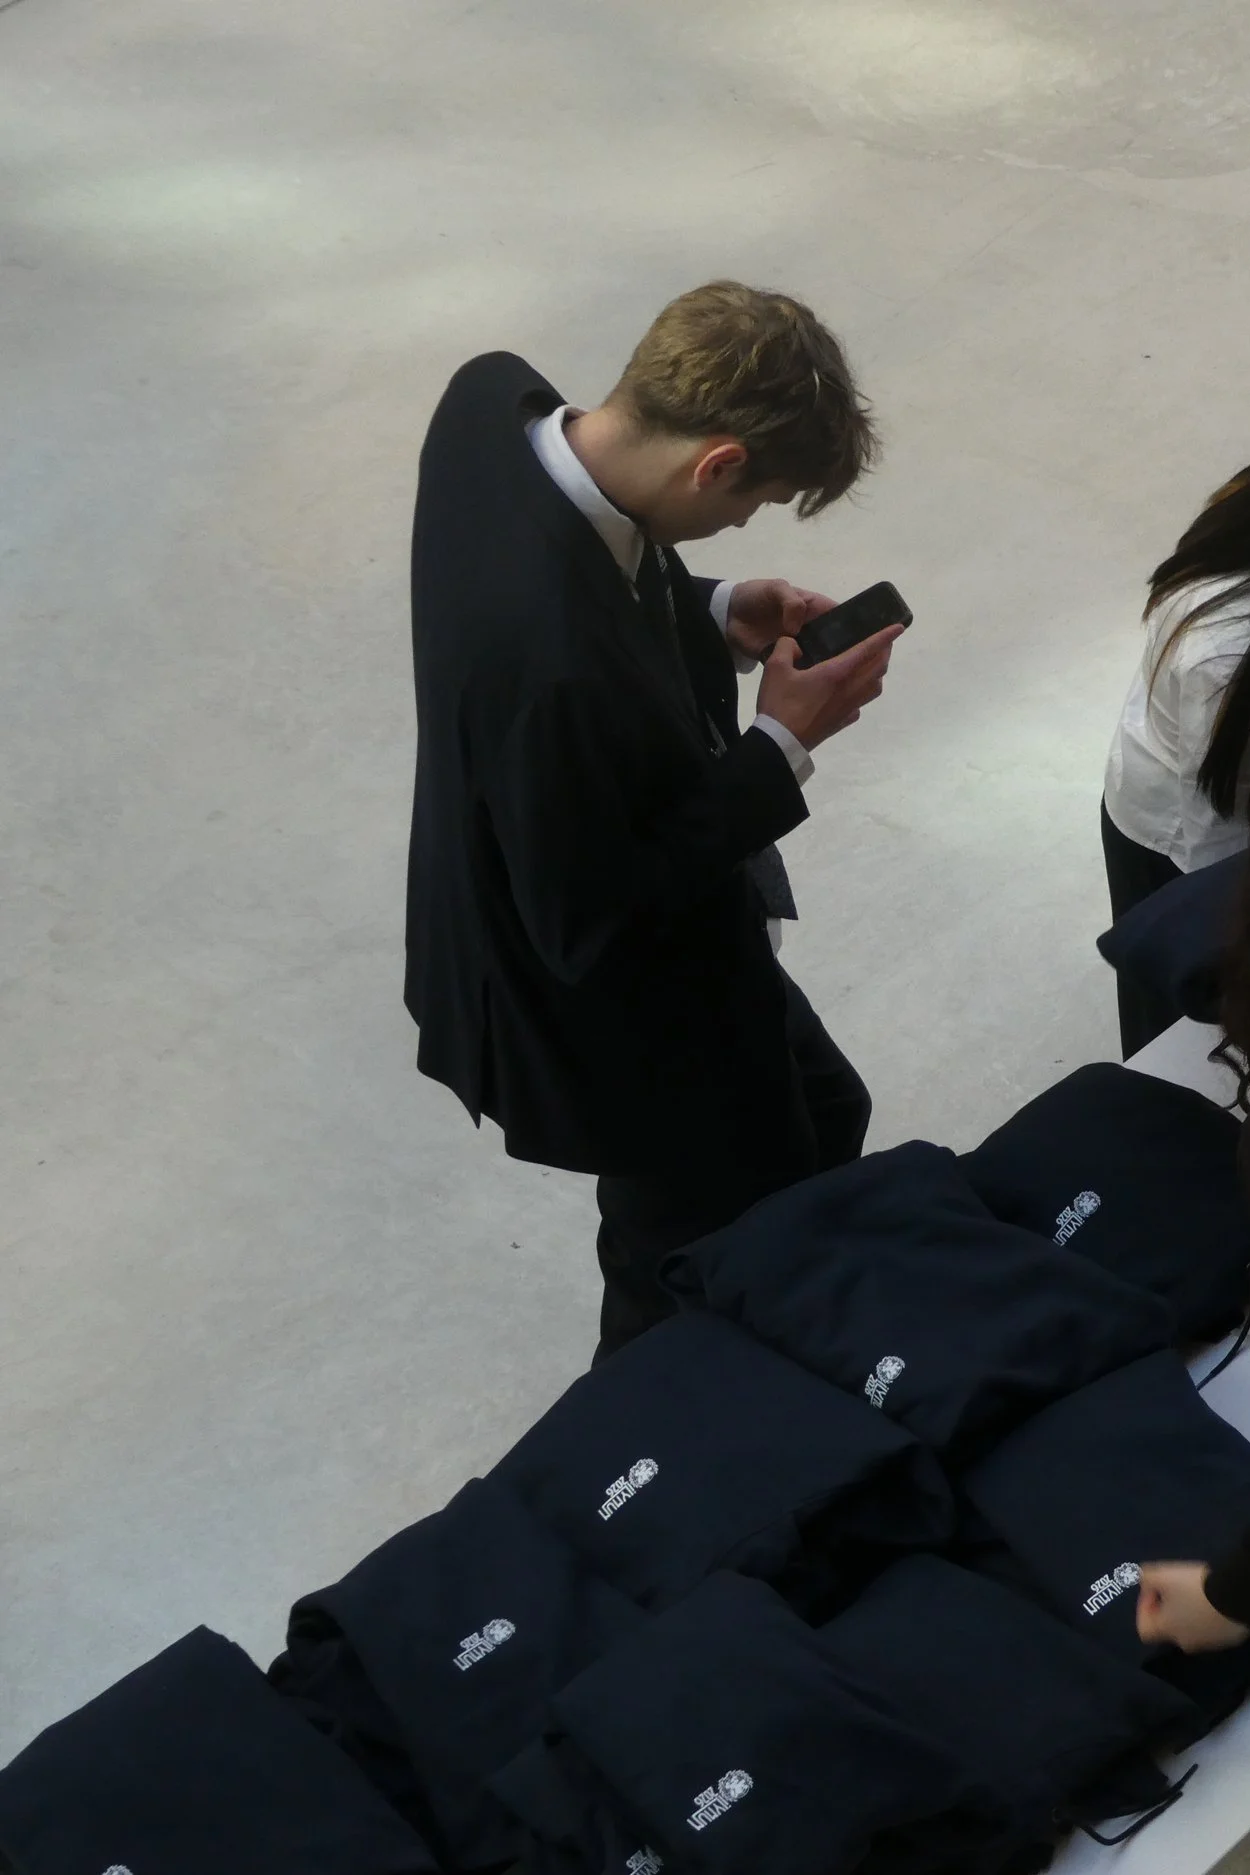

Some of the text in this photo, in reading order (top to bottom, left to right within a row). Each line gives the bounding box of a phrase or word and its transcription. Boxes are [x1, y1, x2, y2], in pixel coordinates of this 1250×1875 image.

[1056, 1206, 1075, 1227] 2026
[865, 1374, 878, 1396] 2026
[605, 1475, 628, 1499] 2026
[1090, 1574, 1113, 1593] 2026
[460, 1632, 484, 1650] 2026
[694, 1786, 718, 1808] 2026
